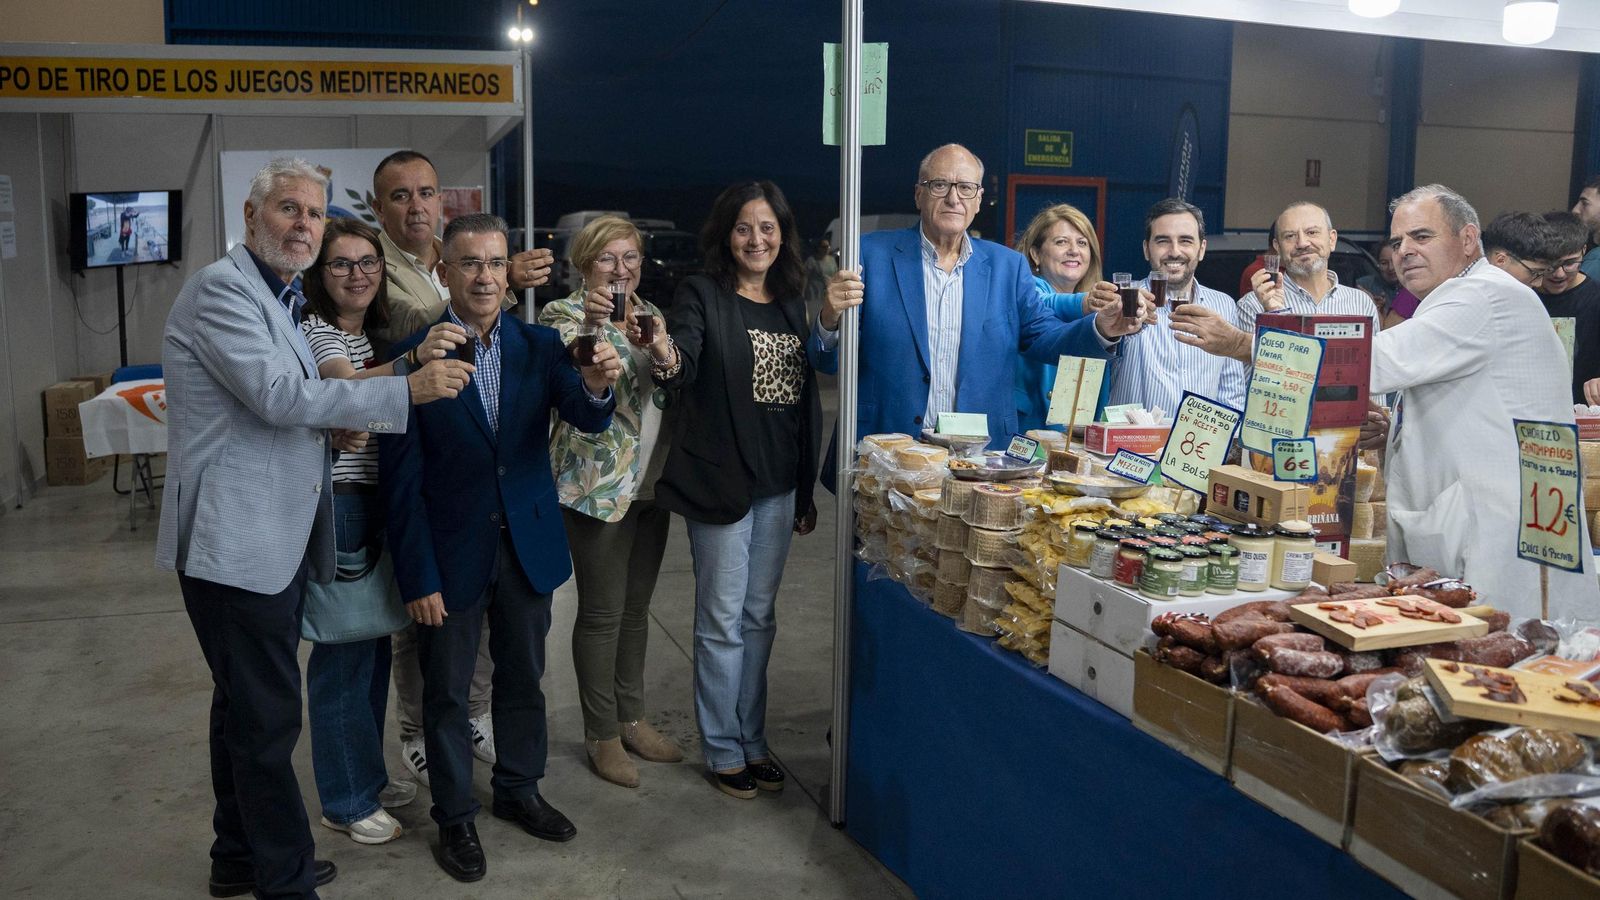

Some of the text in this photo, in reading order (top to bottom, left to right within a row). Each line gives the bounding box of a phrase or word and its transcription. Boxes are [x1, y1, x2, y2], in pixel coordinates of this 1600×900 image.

[38, 67, 69, 91] DE
[75, 67, 129, 92] TIRO
[136, 69, 166, 92] DE
[174, 69, 218, 93] LOS
[224, 69, 313, 93] JUEGOS
[319, 70, 500, 96] MEDITERRANEOS
[1038, 134, 1061, 143] SALIDA
[1044, 144, 1054, 153] DE
[1028, 154, 1069, 164] EMERGENCIA
[1260, 336, 1310, 355] QUESO PARA
[1259, 348, 1283, 361] UNTAR
[1187, 397, 1212, 413] QUESO
[1179, 414, 1218, 435] EN ACEITE
[1520, 426, 1561, 442] CHORIZO
[1180, 431, 1210, 460] 8€
[1117, 459, 1144, 474] MEZCLA
[1165, 452, 1176, 467] LA
[1540, 465, 1547, 473] DE
[1548, 466, 1555, 474] 4
